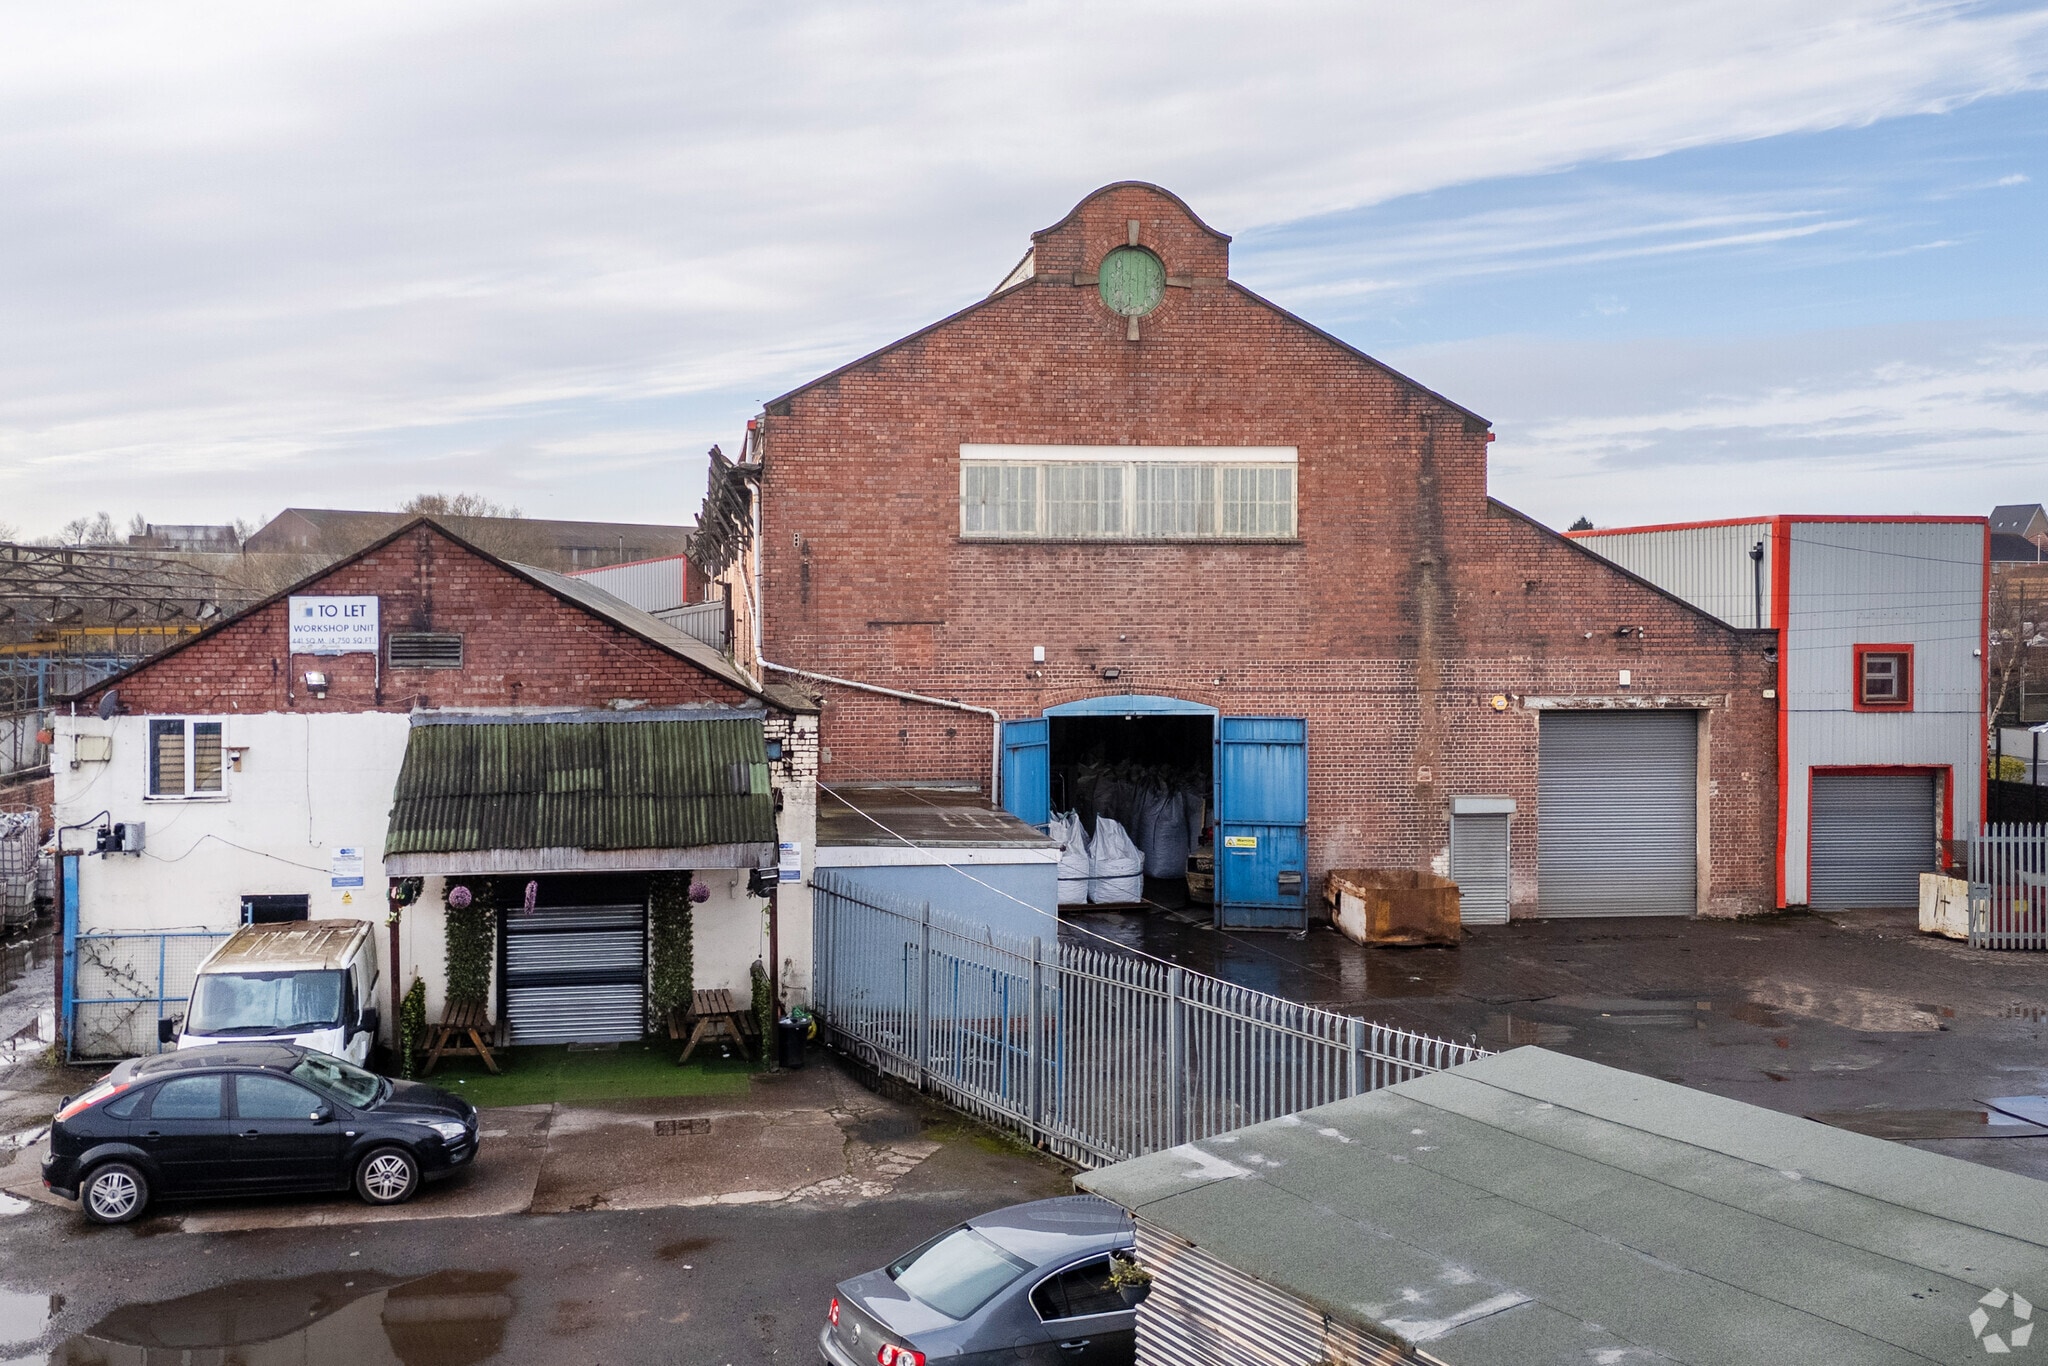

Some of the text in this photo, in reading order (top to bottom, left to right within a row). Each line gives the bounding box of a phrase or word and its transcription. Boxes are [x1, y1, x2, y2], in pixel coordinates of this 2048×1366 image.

[318, 604, 367, 617] TO LET
[293, 624, 374, 632] WORKSHOP UNIT
